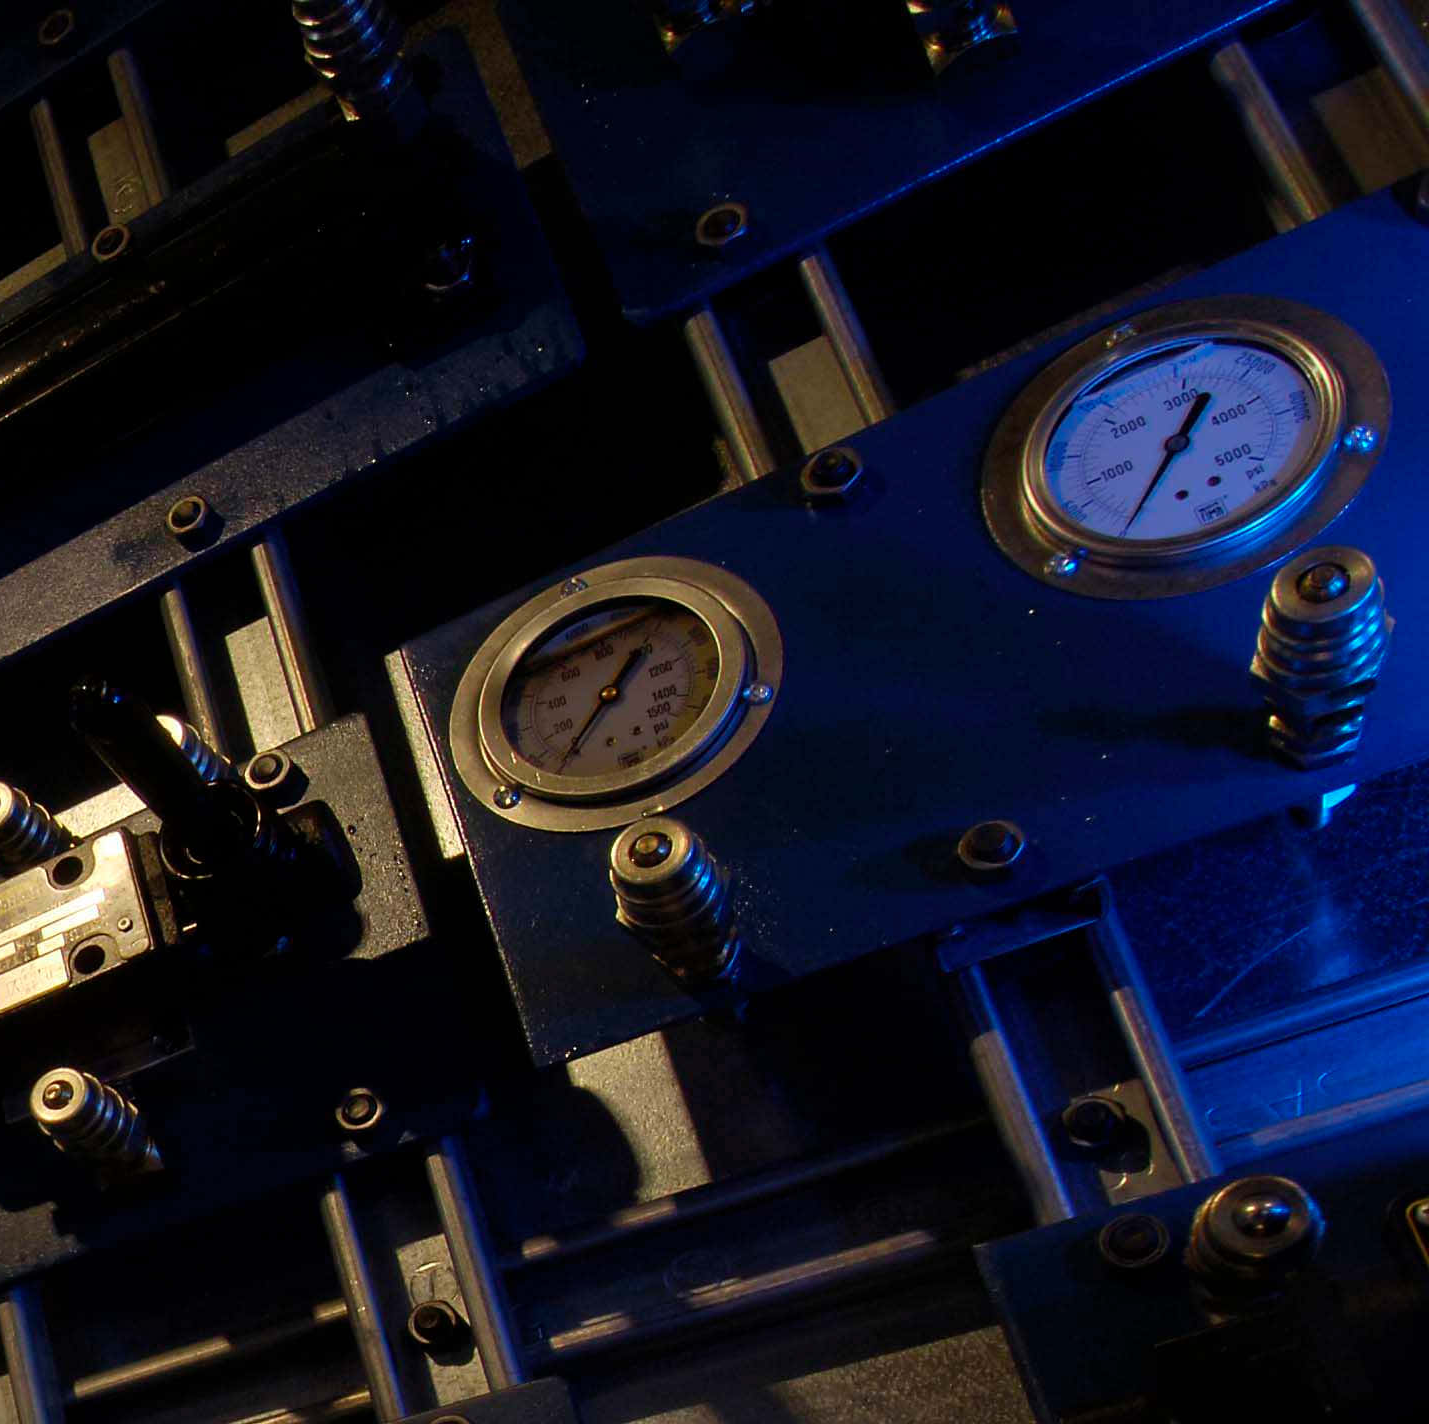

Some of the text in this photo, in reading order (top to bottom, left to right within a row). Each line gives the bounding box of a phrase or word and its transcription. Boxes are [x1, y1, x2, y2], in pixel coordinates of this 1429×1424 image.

[1163, 388, 1199, 411] 3000
[1212, 404, 1247, 426] 4000
[1111, 416, 1146, 439] 2000
[1215, 444, 1252, 466] 5000
[1101, 460, 1133, 482] 1000
[648, 661, 672, 678] 1200
[651, 684, 677, 702] 1400
[647, 702, 671, 718] 1500
